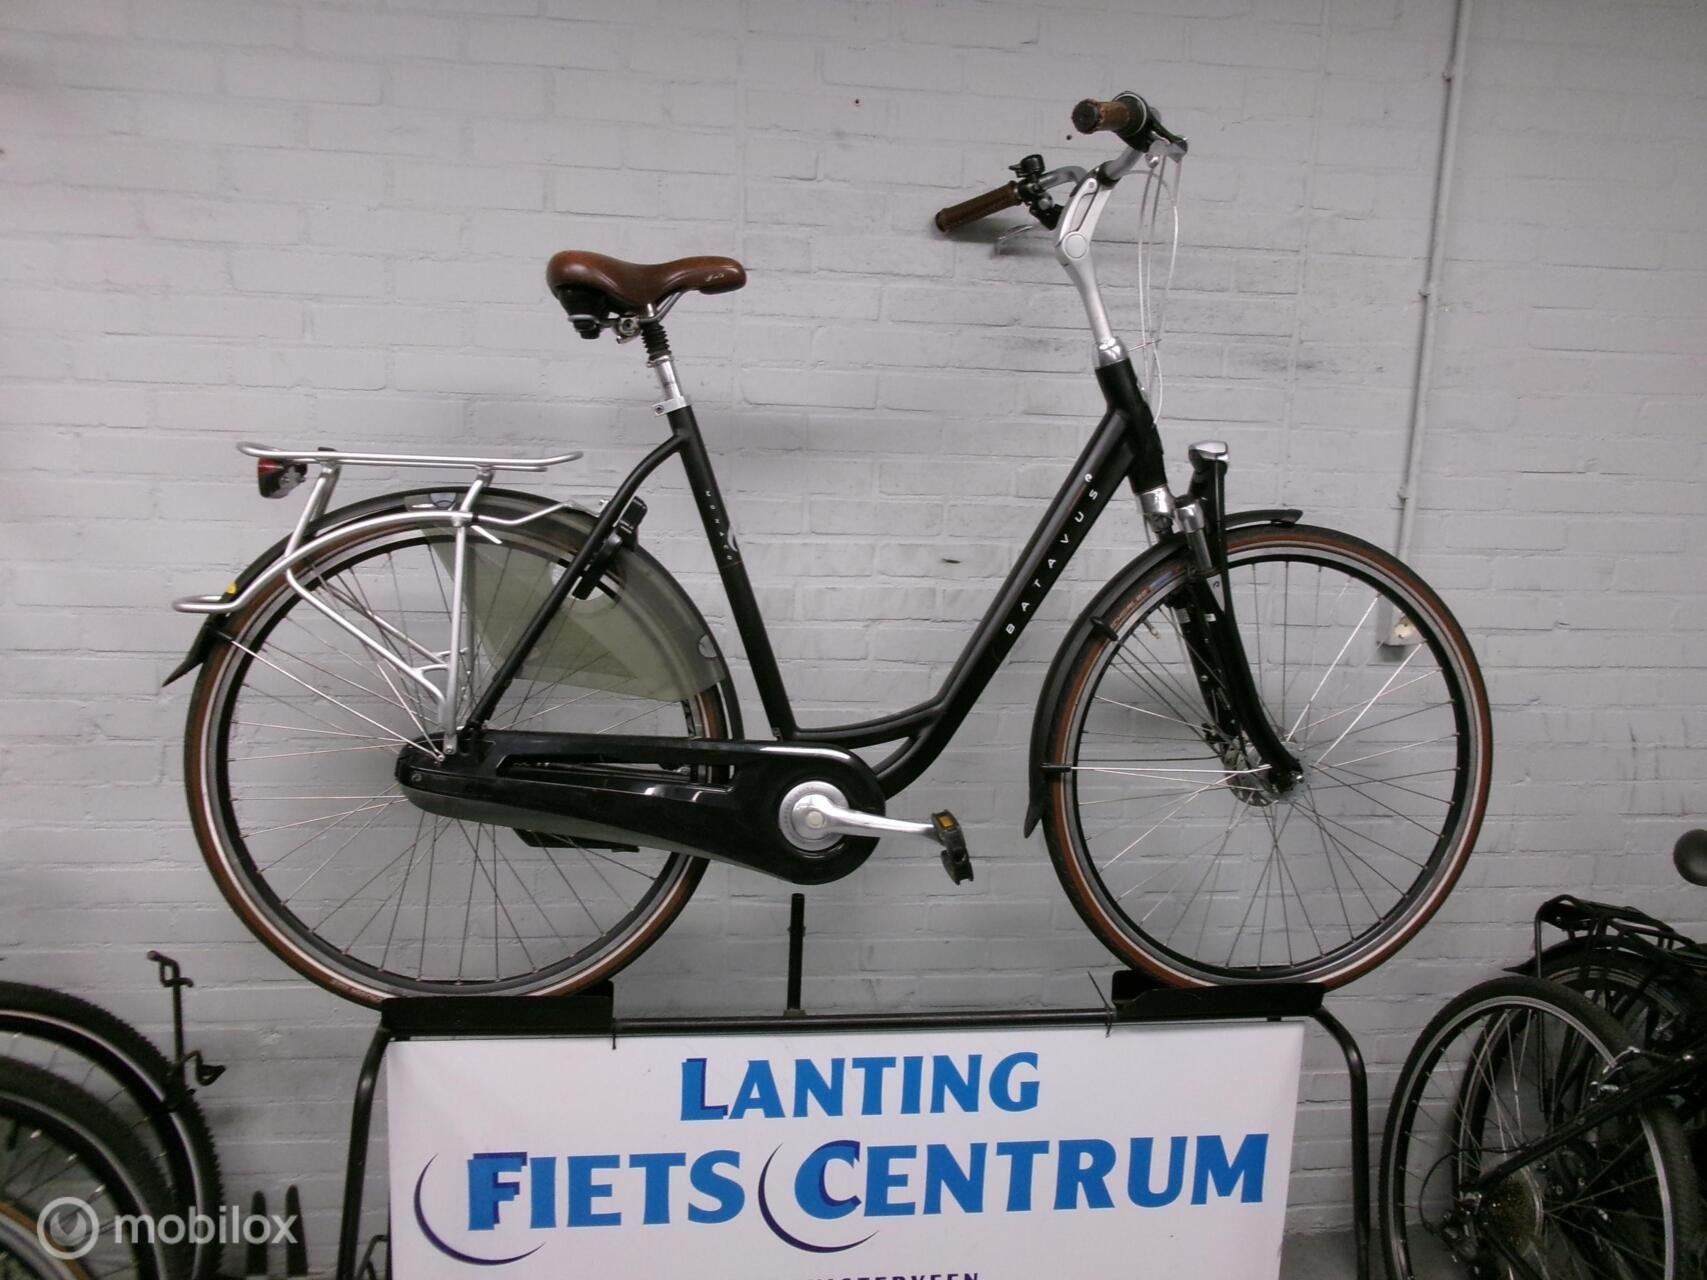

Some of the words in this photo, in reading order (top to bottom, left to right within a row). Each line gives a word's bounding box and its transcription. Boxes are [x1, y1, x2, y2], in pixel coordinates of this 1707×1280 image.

[1005, 488, 1099, 635] BATAVUS
[681, 1051, 1041, 1122] LANTING
[467, 1151, 747, 1232] FIETS
[794, 1134, 1270, 1222] CENTRUM
